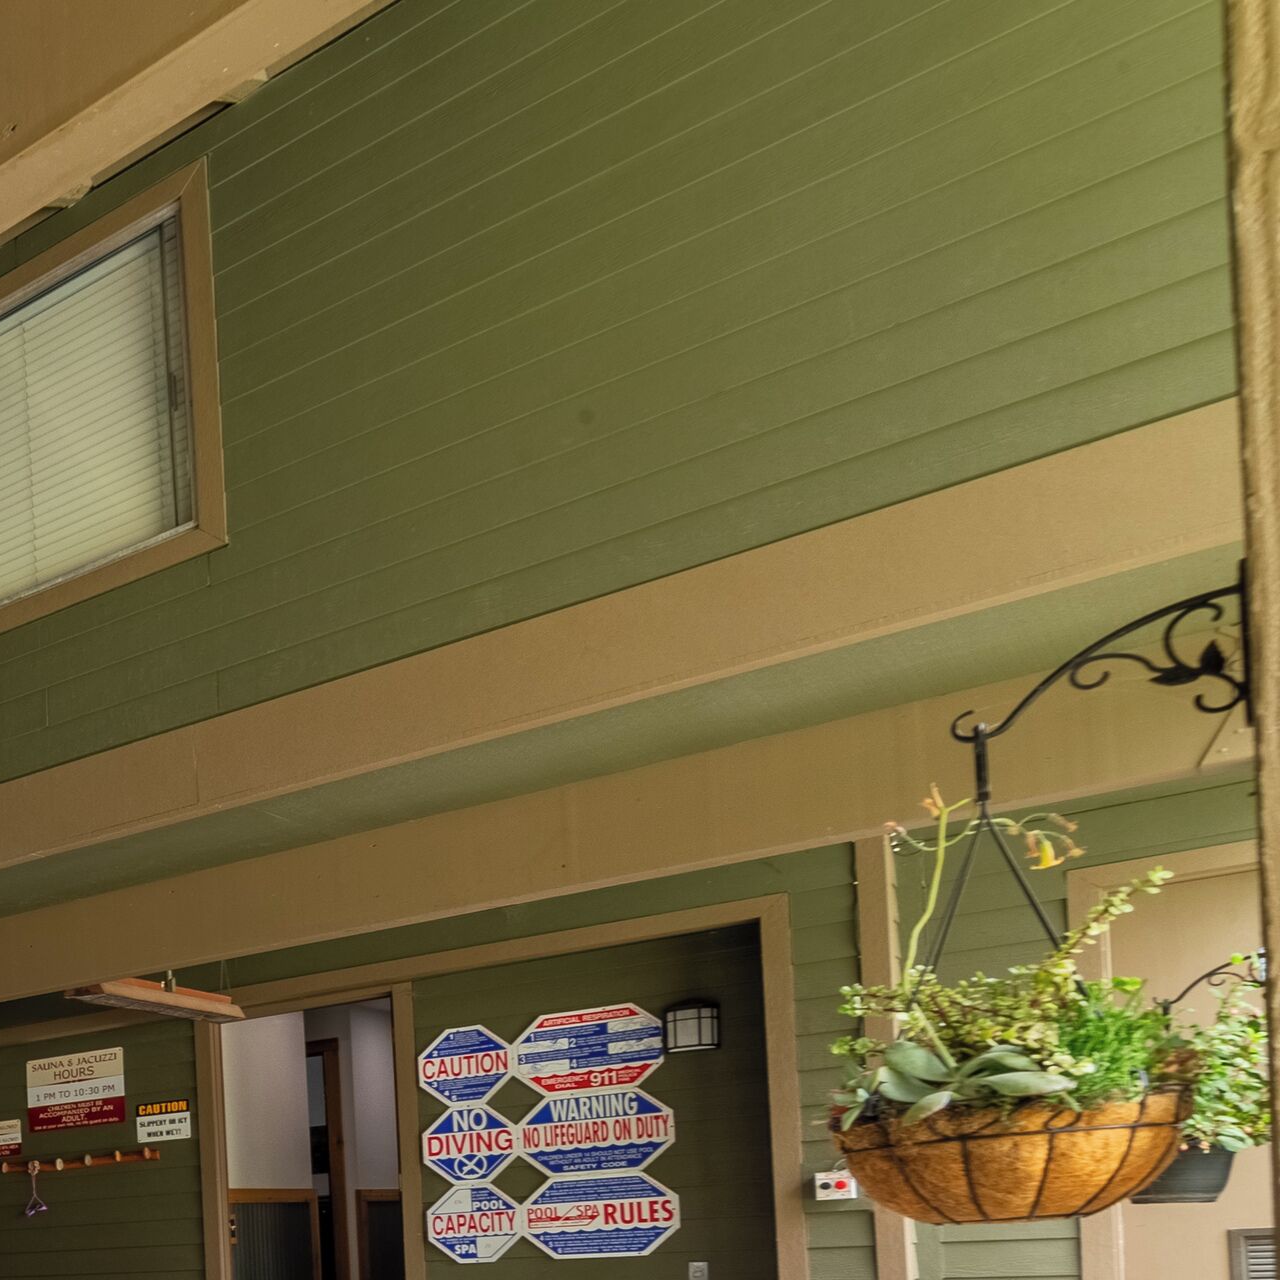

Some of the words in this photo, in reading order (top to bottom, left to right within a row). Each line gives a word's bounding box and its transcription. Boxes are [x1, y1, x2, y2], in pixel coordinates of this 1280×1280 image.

[32, 1061, 64, 1072] SAUNA
[77, 1053, 117, 1066] JACUZZI
[423, 1051, 508, 1080] CAUTION
[54, 1066, 95, 1080] HOURS
[590, 1071, 617, 1087] 911
[36, 1094, 40, 1102] 1
[44, 1092, 56, 1100] PM
[59, 1090, 71, 1098] TO
[74, 1086, 99, 1097] 10:30
[102, 1084, 115, 1093] PM
[39, 1107, 90, 1119] ACCOMPANIED
[138, 1100, 187, 1116] CAUTION
[549, 1092, 638, 1122] WARNING
[139, 1119, 167, 1128] SLIPPERY
[452, 1108, 488, 1132] NO
[523, 1127, 540, 1149] NO
[544, 1120, 609, 1147] LIFEGUARD
[614, 1118, 631, 1141] ON
[637, 1114, 669, 1138] DUTY
[427, 1129, 513, 1157] DIVING
[562, 1163, 597, 1171] SAFETY
[601, 1160, 628, 1168] CODE
[472, 1200, 507, 1211] POOL
[527, 1207, 559, 1218] POOL
[576, 1205, 599, 1216] SPA
[604, 1200, 674, 1225] RULES
[433, 1211, 515, 1235] CAPACITY
[454, 1244, 477, 1254] SPA
